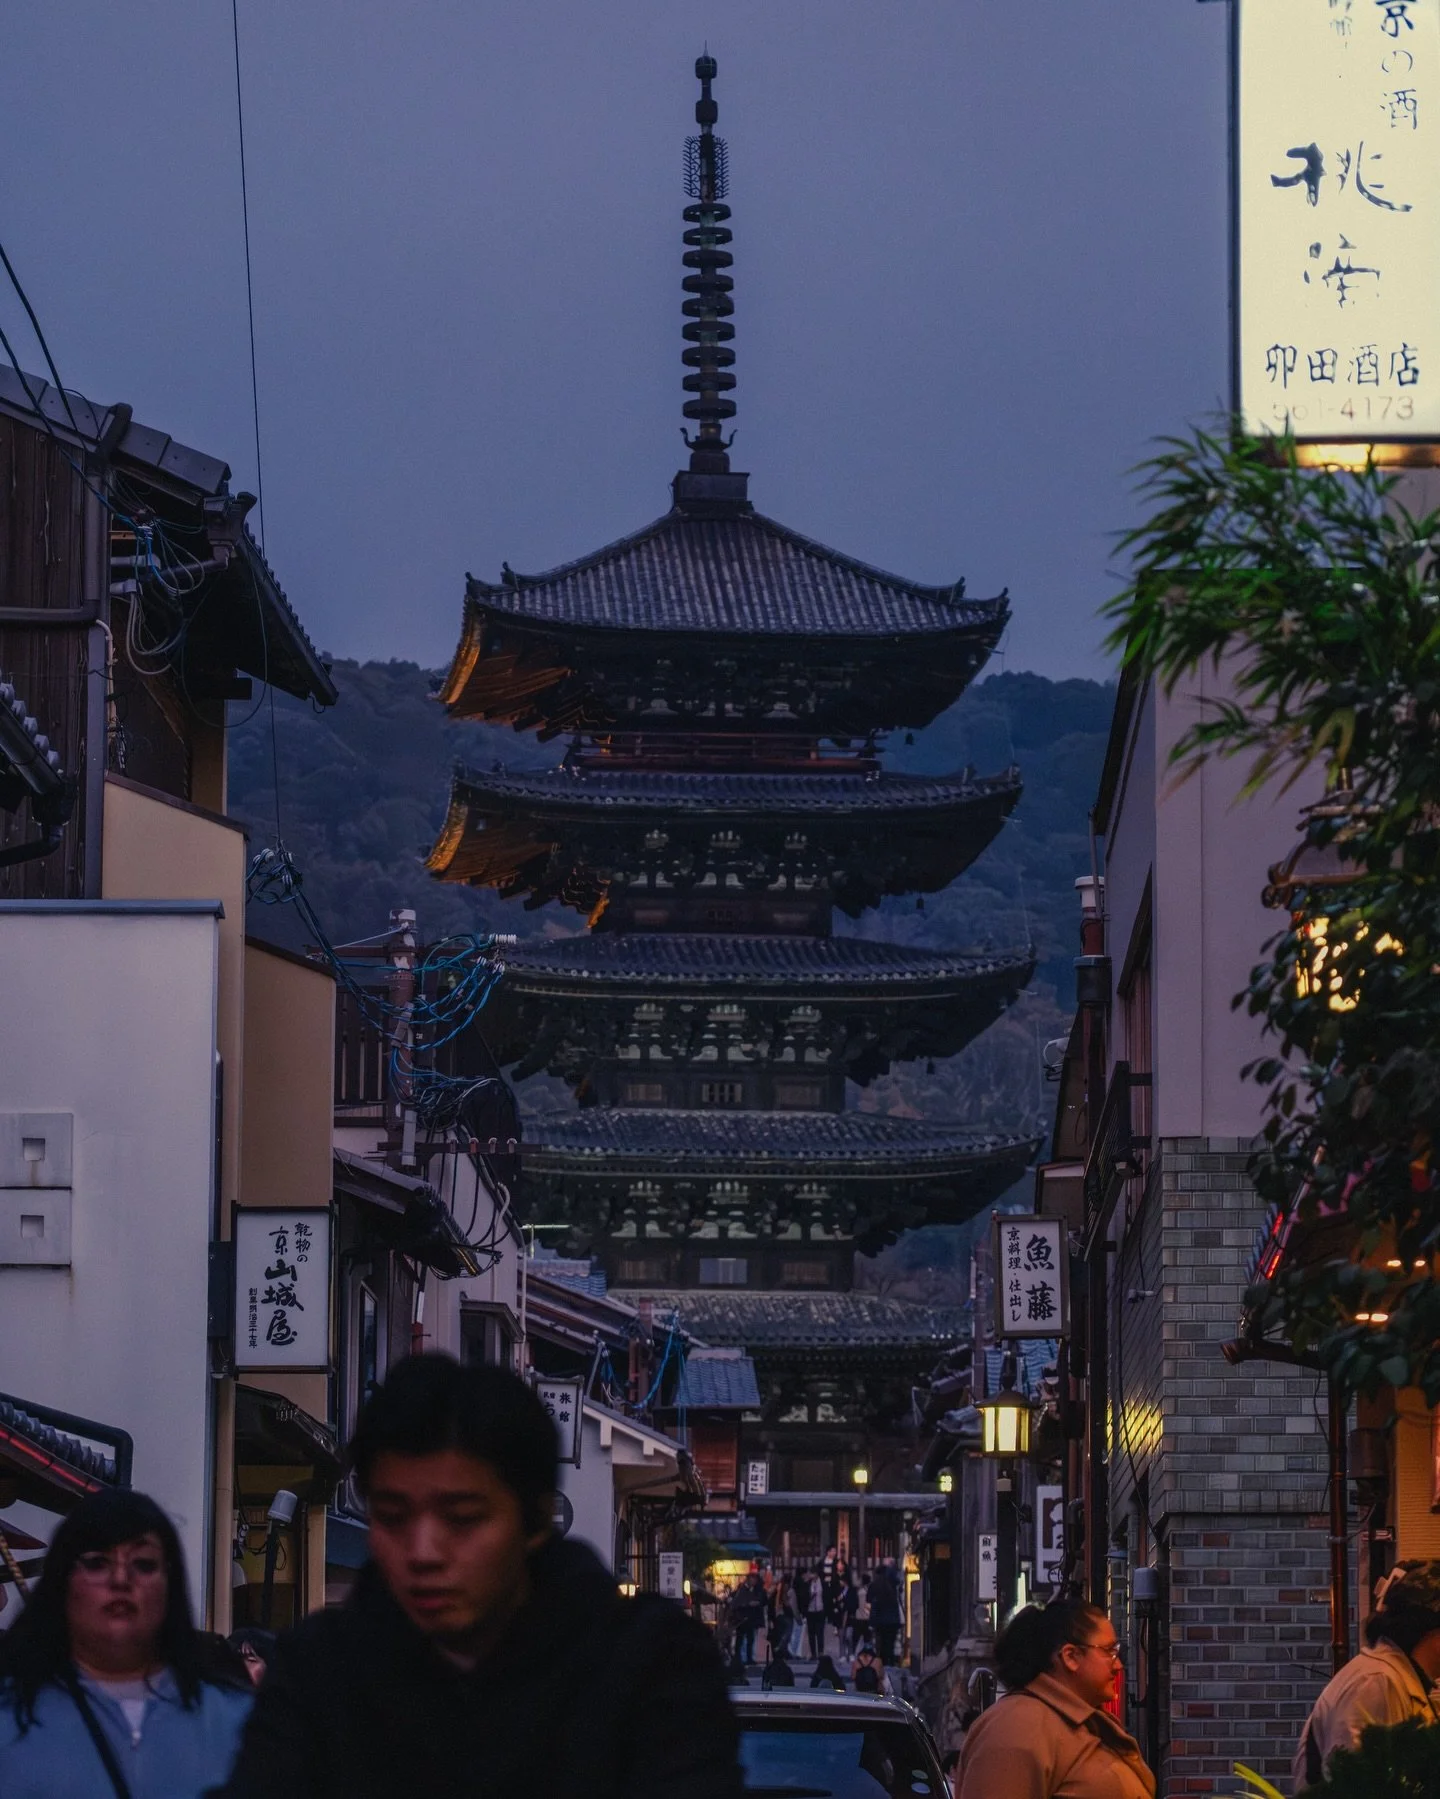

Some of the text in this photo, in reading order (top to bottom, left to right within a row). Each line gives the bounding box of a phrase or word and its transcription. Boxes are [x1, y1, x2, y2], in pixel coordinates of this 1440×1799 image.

[294, 1222, 313, 1263] 乾物の
[1007, 1227, 1022, 1321] 京料理・仕出し
[1024, 1233, 1057, 1321] 魚藤
